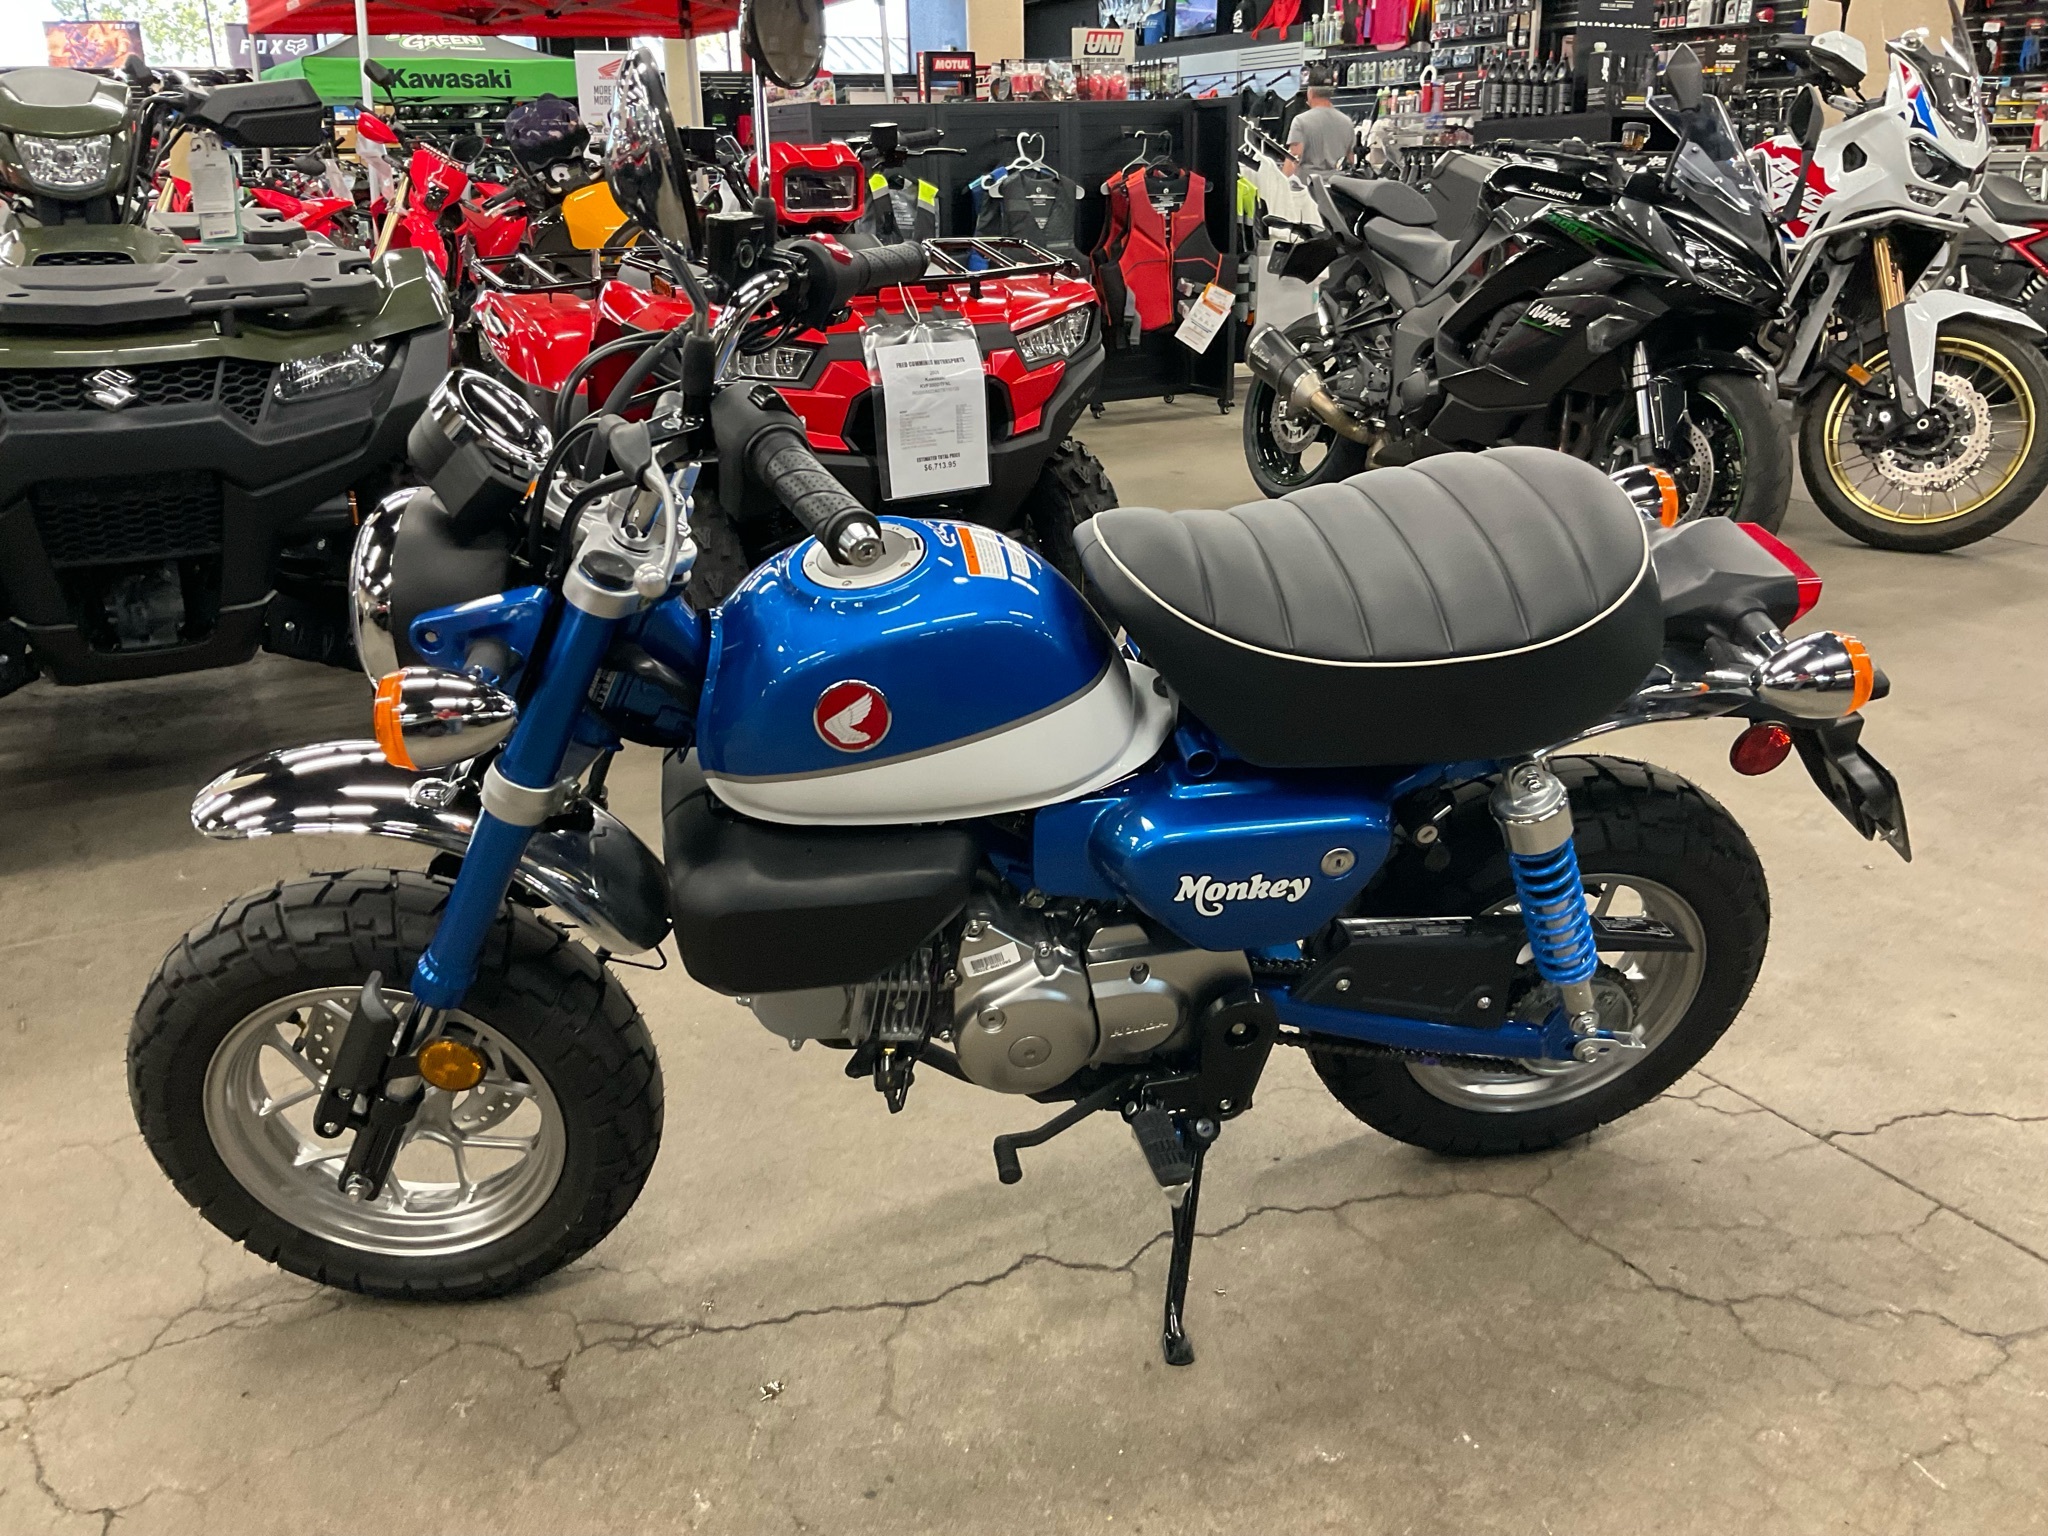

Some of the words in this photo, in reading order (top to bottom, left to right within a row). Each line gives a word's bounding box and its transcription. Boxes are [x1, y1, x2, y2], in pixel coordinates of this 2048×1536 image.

[401, 35, 481, 50] GREEN
[1085, 32, 1122, 54] UNI
[934, 59, 970, 70] MOTUL
[387, 68, 512, 89] Kawasaki
[593, 85, 612, 95] MORE
[593, 95, 612, 105] MORE
[1528, 303, 1571, 328] Ninja
[924, 461, 956, 471] $6,713.95
[1174, 874, 1311, 916] Monkey
